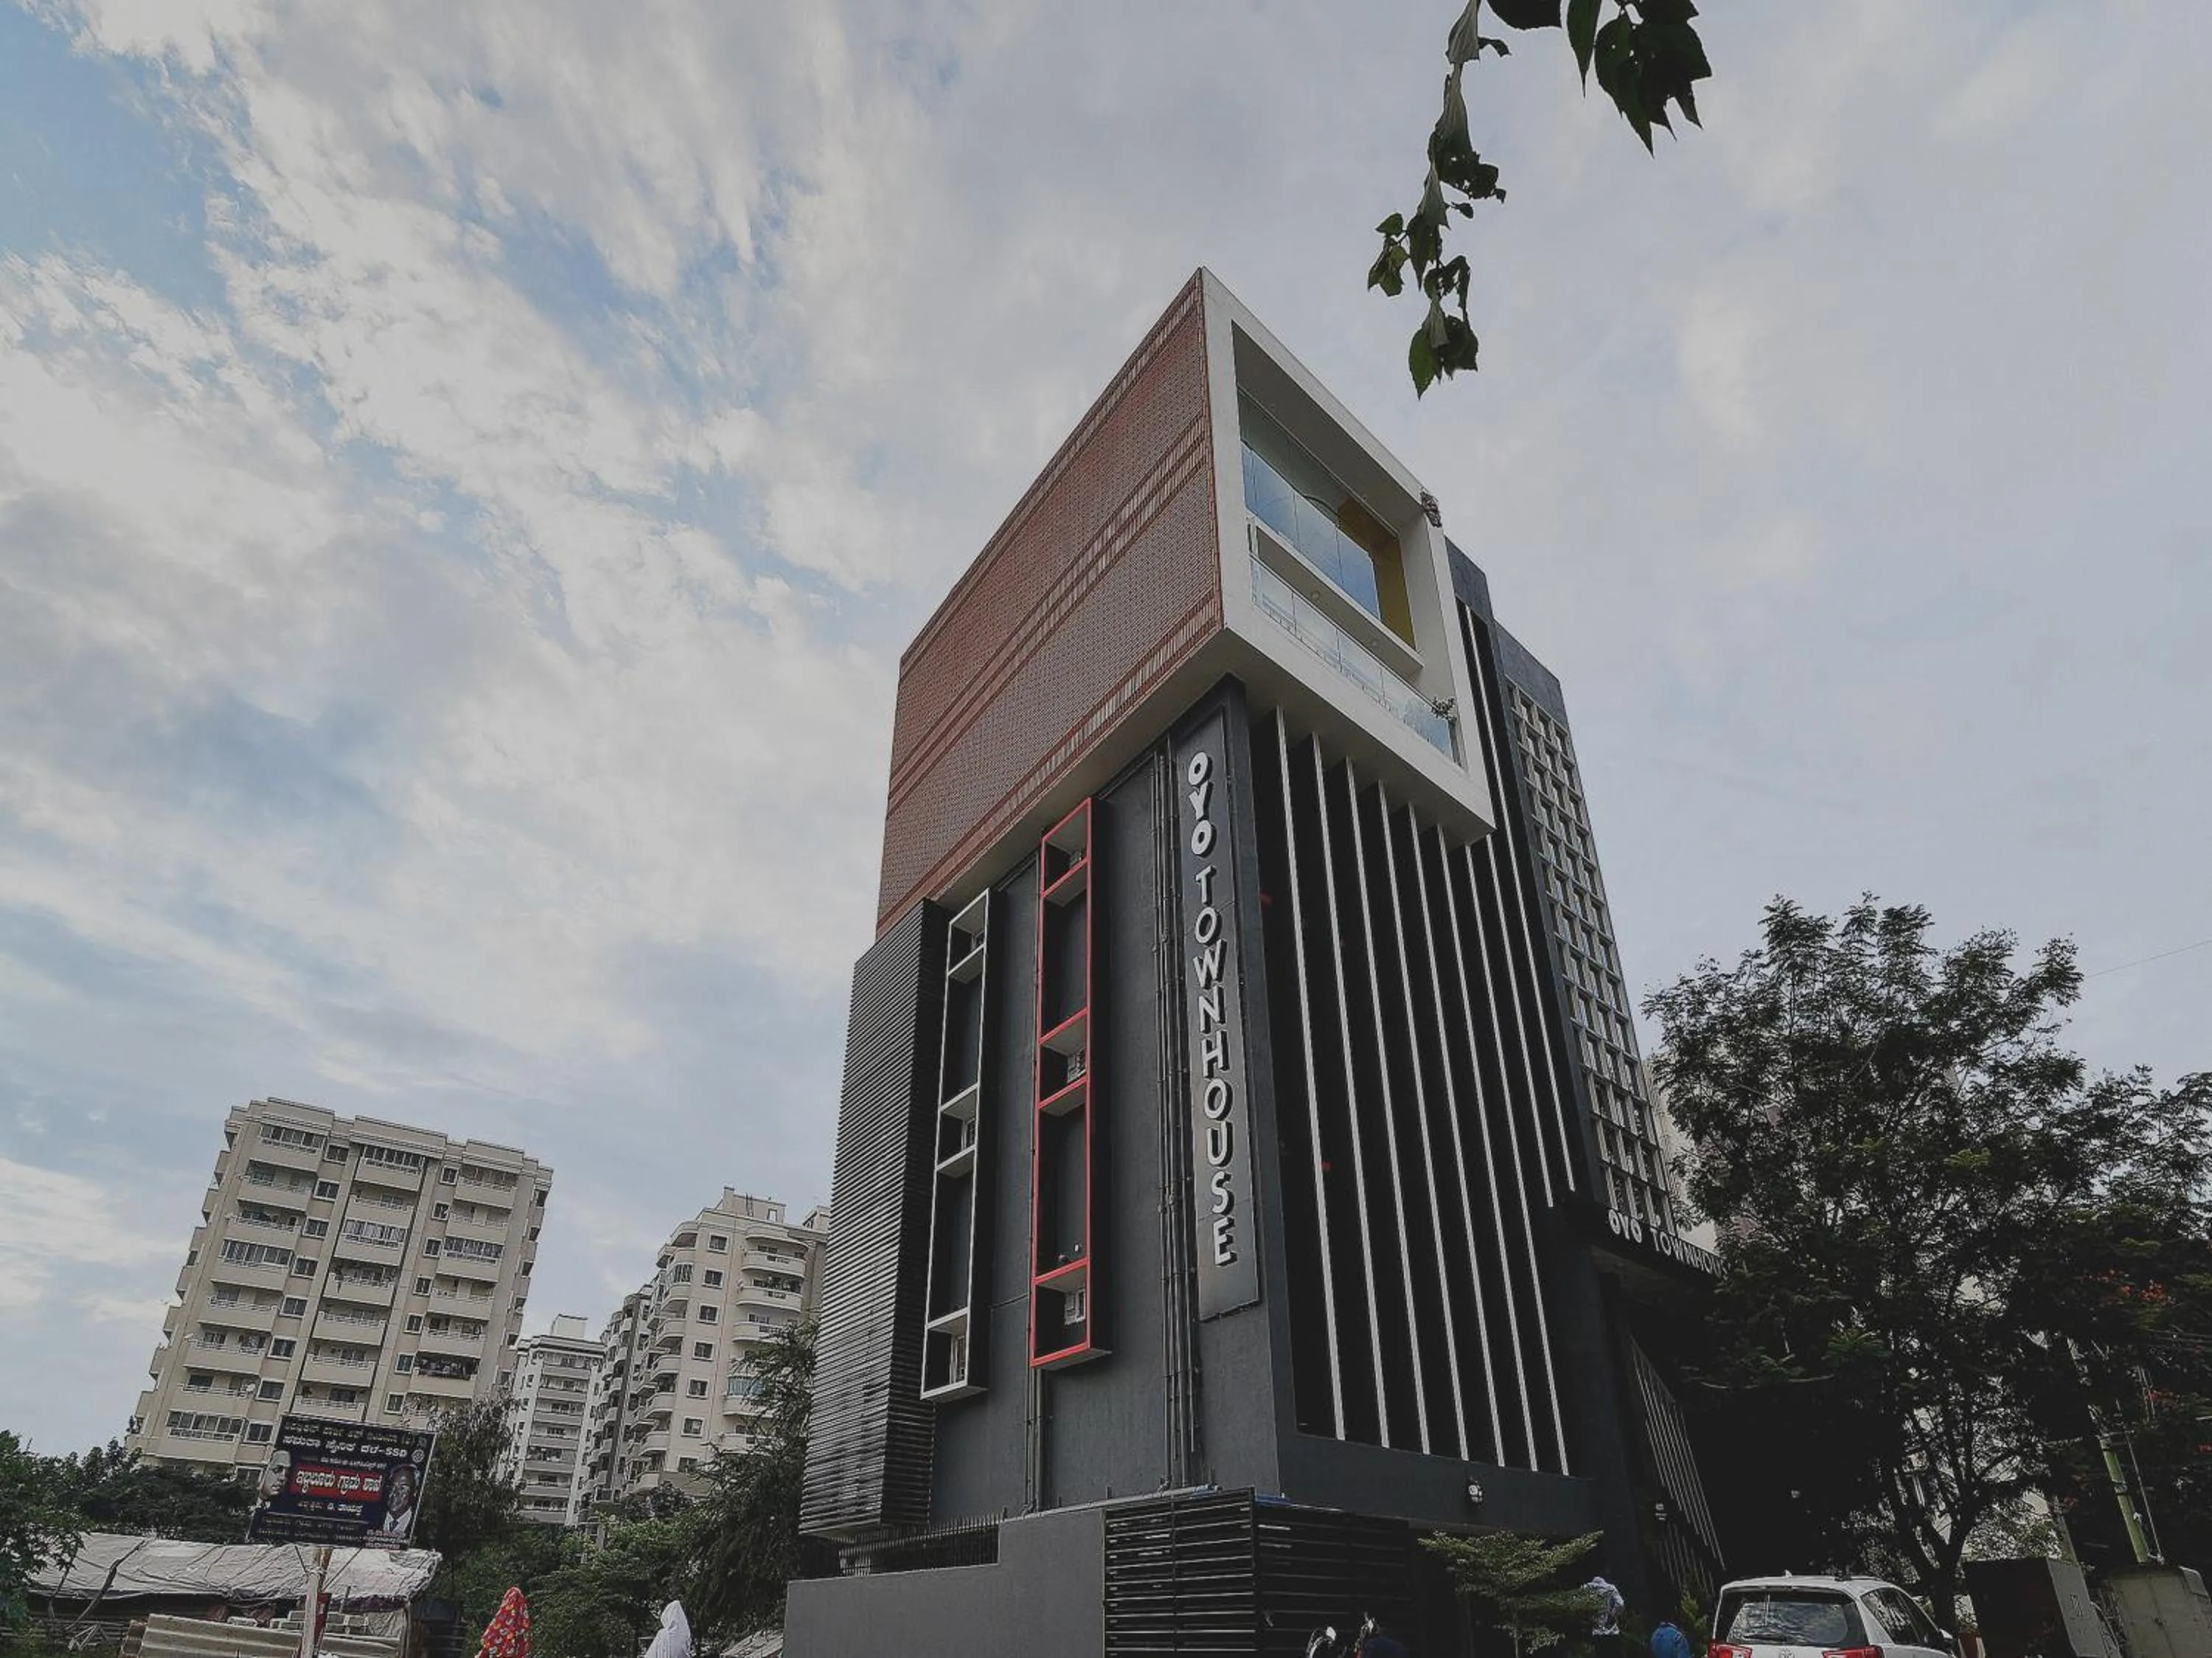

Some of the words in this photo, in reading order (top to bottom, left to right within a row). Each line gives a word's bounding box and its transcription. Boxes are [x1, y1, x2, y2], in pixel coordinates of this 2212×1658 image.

[1187, 751, 1217, 858] OYO
[1192, 865, 1239, 1267] TOWNHOUSE
[1608, 1209, 1642, 1244] OYO
[1650, 1227, 1730, 1280] TOWNHOUS
